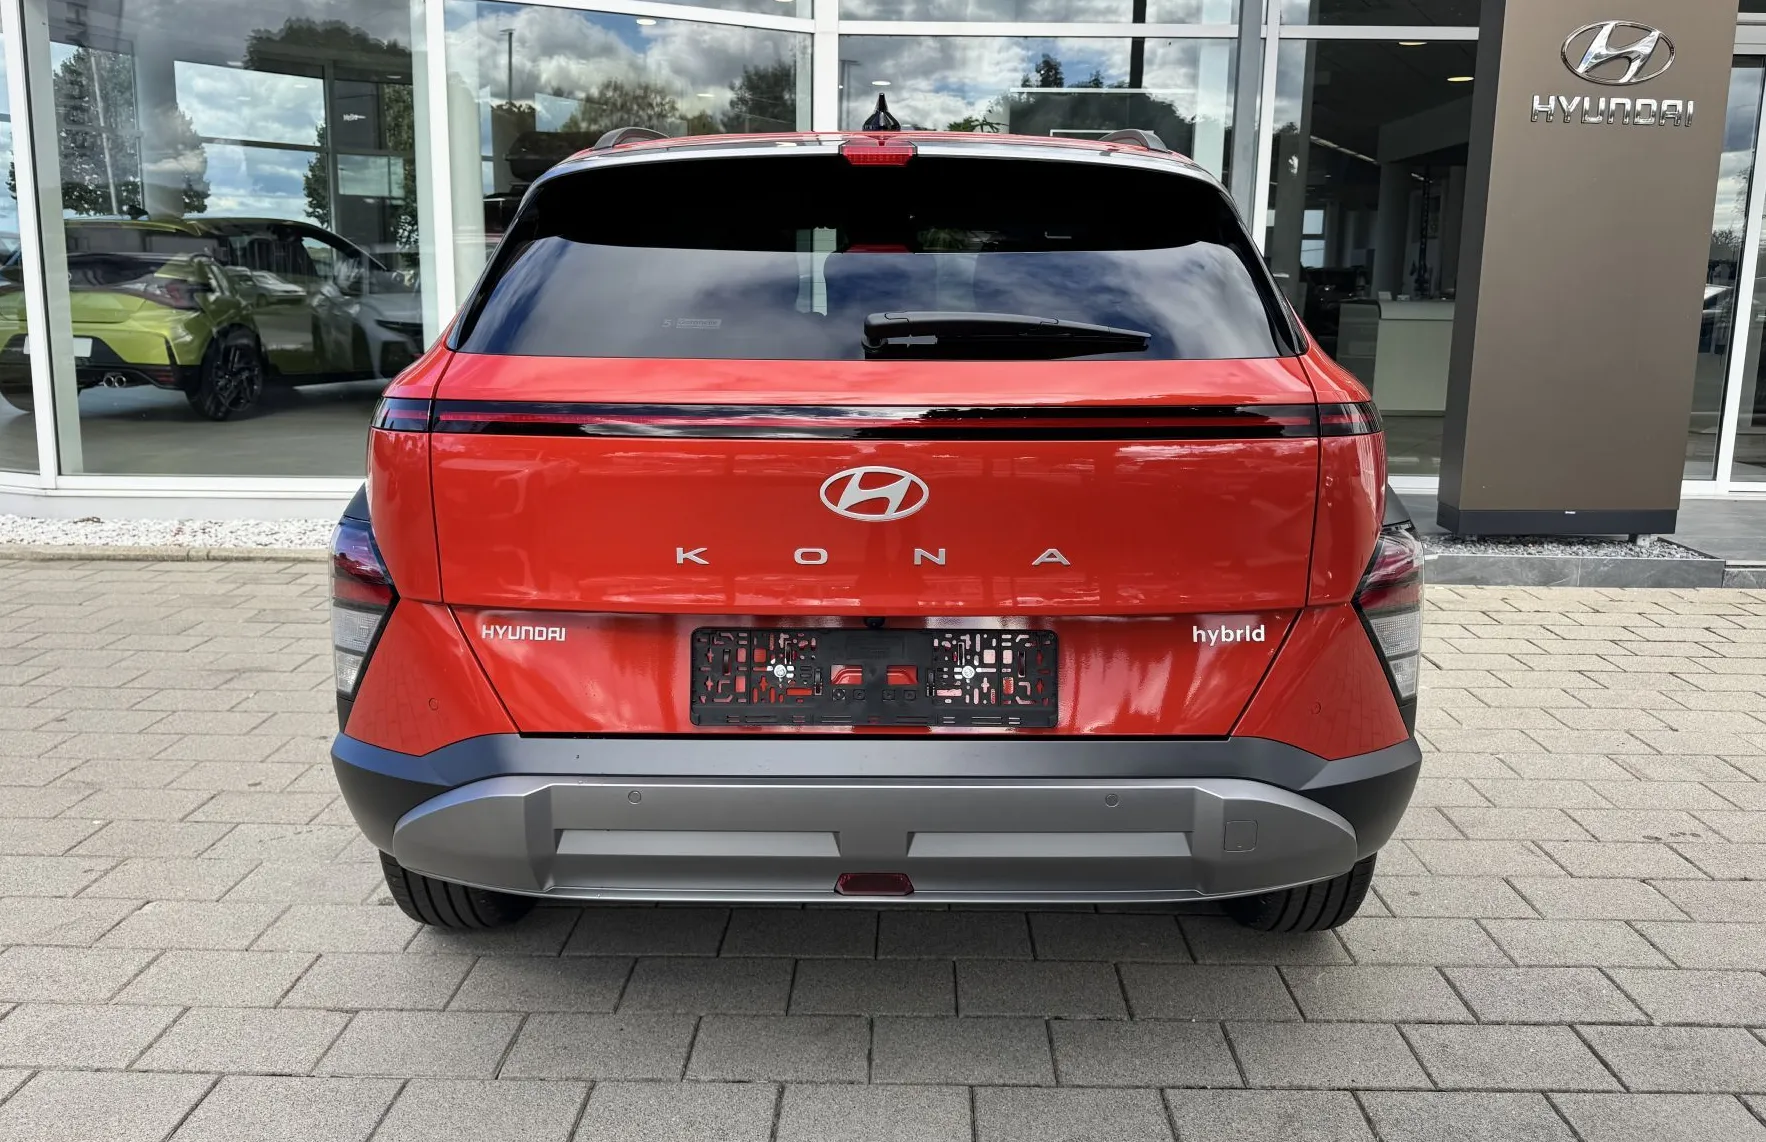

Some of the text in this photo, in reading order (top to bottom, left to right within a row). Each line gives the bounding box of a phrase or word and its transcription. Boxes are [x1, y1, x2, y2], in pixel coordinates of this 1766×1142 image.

[1531, 95, 1694, 127] HYUNDAI
[676, 547, 1071, 566] KONA
[481, 624, 566, 642] HYUNDAI
[1192, 624, 1266, 647] hybrid
